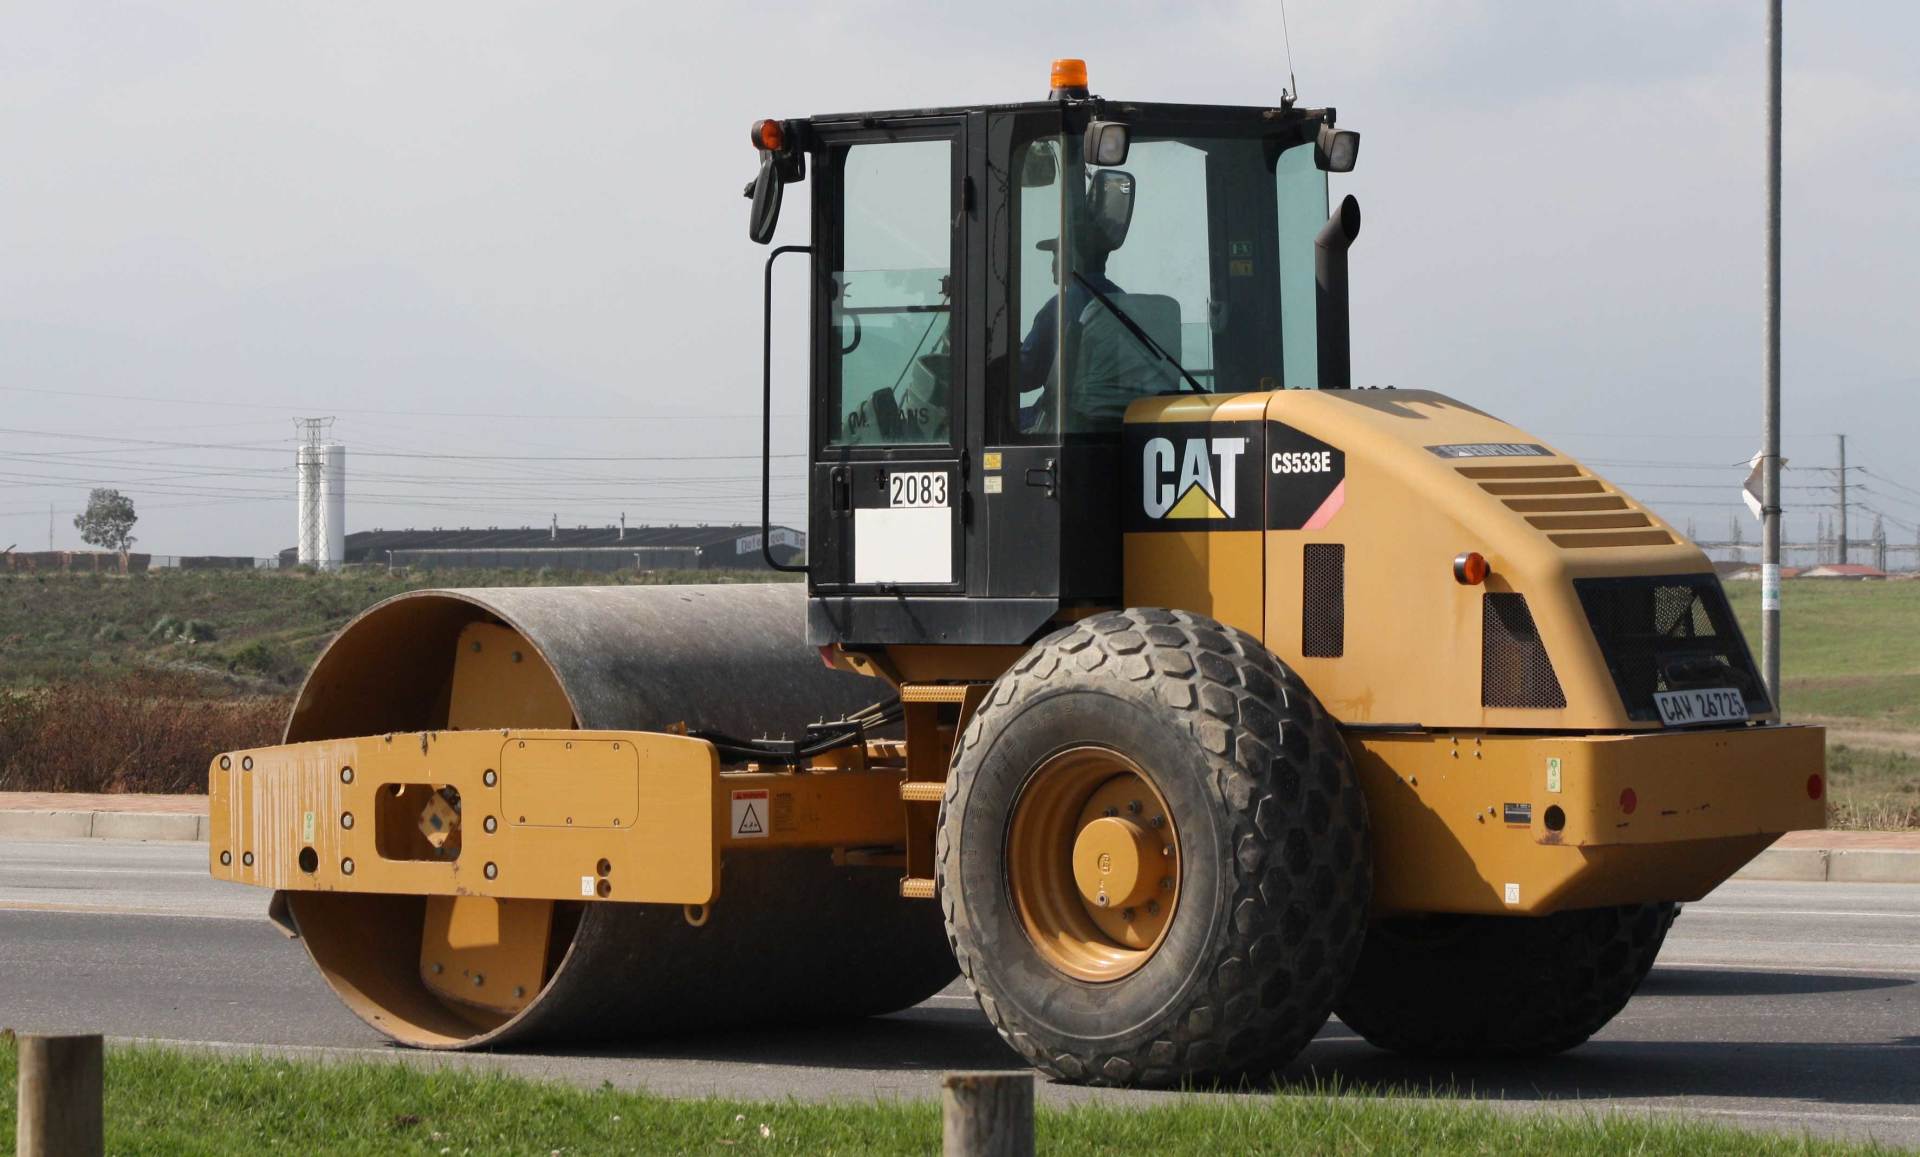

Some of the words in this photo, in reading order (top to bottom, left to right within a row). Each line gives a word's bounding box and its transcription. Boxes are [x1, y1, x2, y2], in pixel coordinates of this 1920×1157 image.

[1271, 451, 1331, 474] CS533E
[892, 474, 946, 505] 2083
[1143, 437, 1245, 519] CAT
[1696, 692, 1745, 718] 26725
